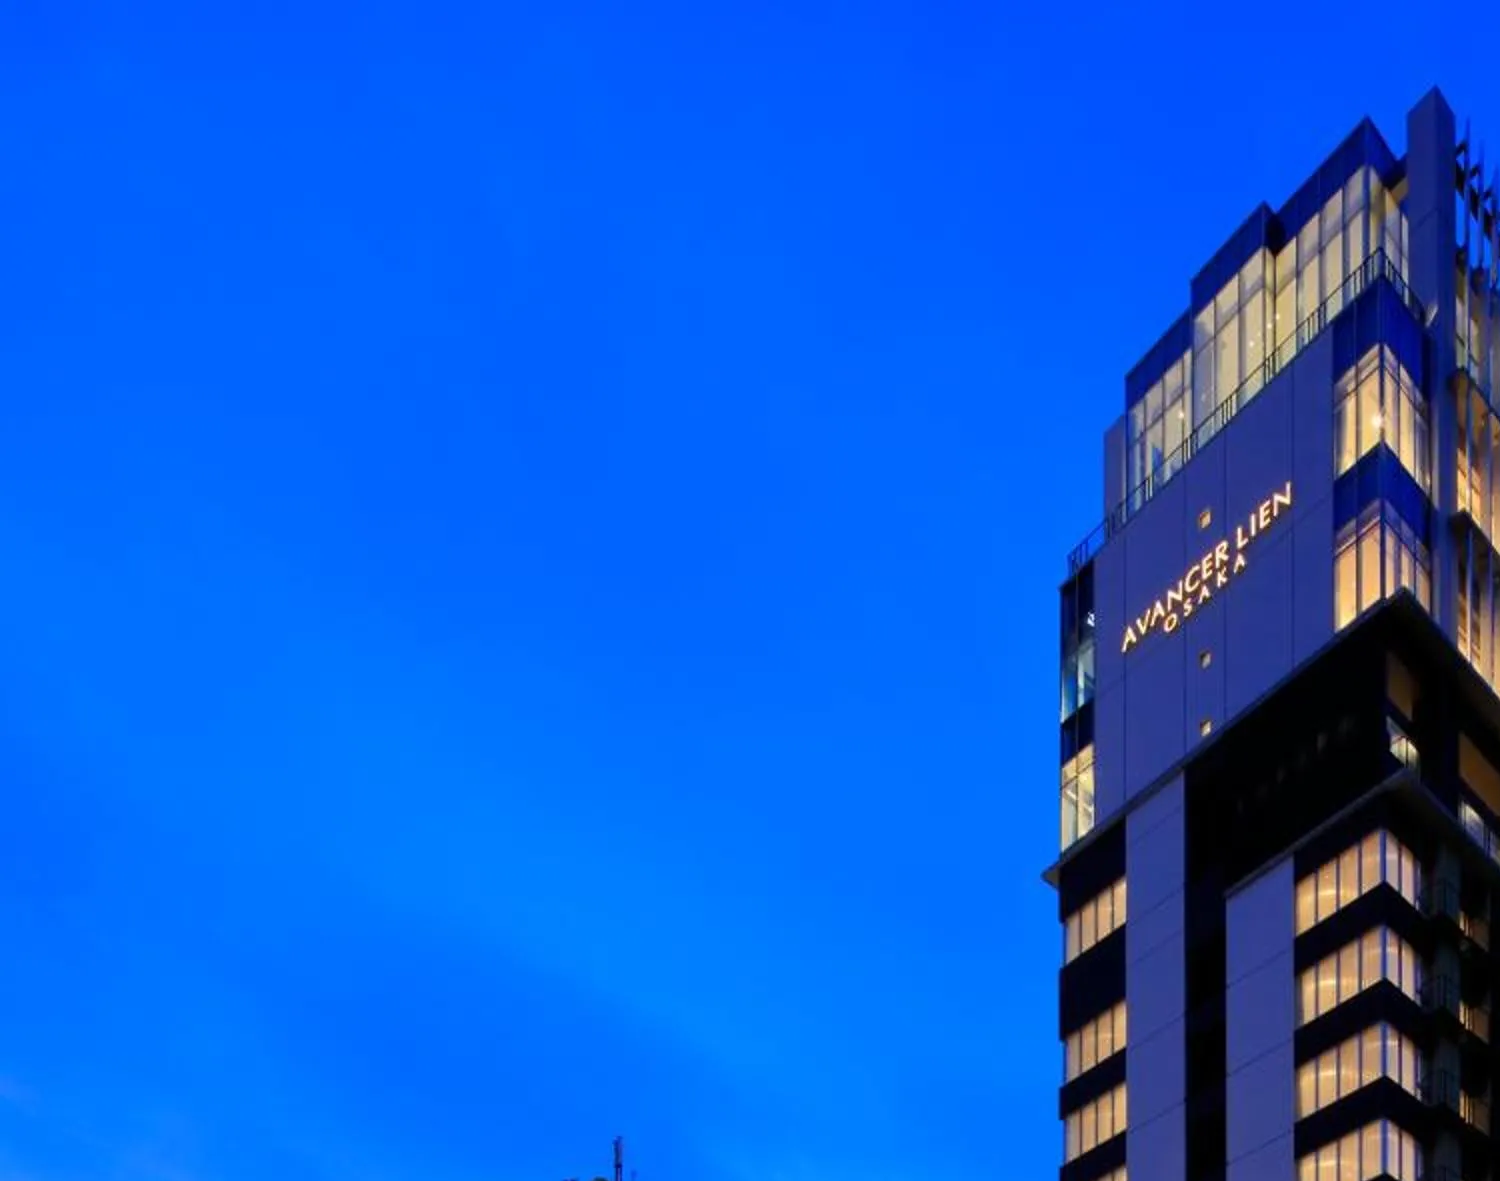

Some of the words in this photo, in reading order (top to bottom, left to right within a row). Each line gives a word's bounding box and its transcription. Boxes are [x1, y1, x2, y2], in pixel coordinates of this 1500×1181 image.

[1121, 540, 1229, 653] AVANCER
[1236, 481, 1292, 550] LIEN
[1163, 553, 1246, 633] OSAKA
